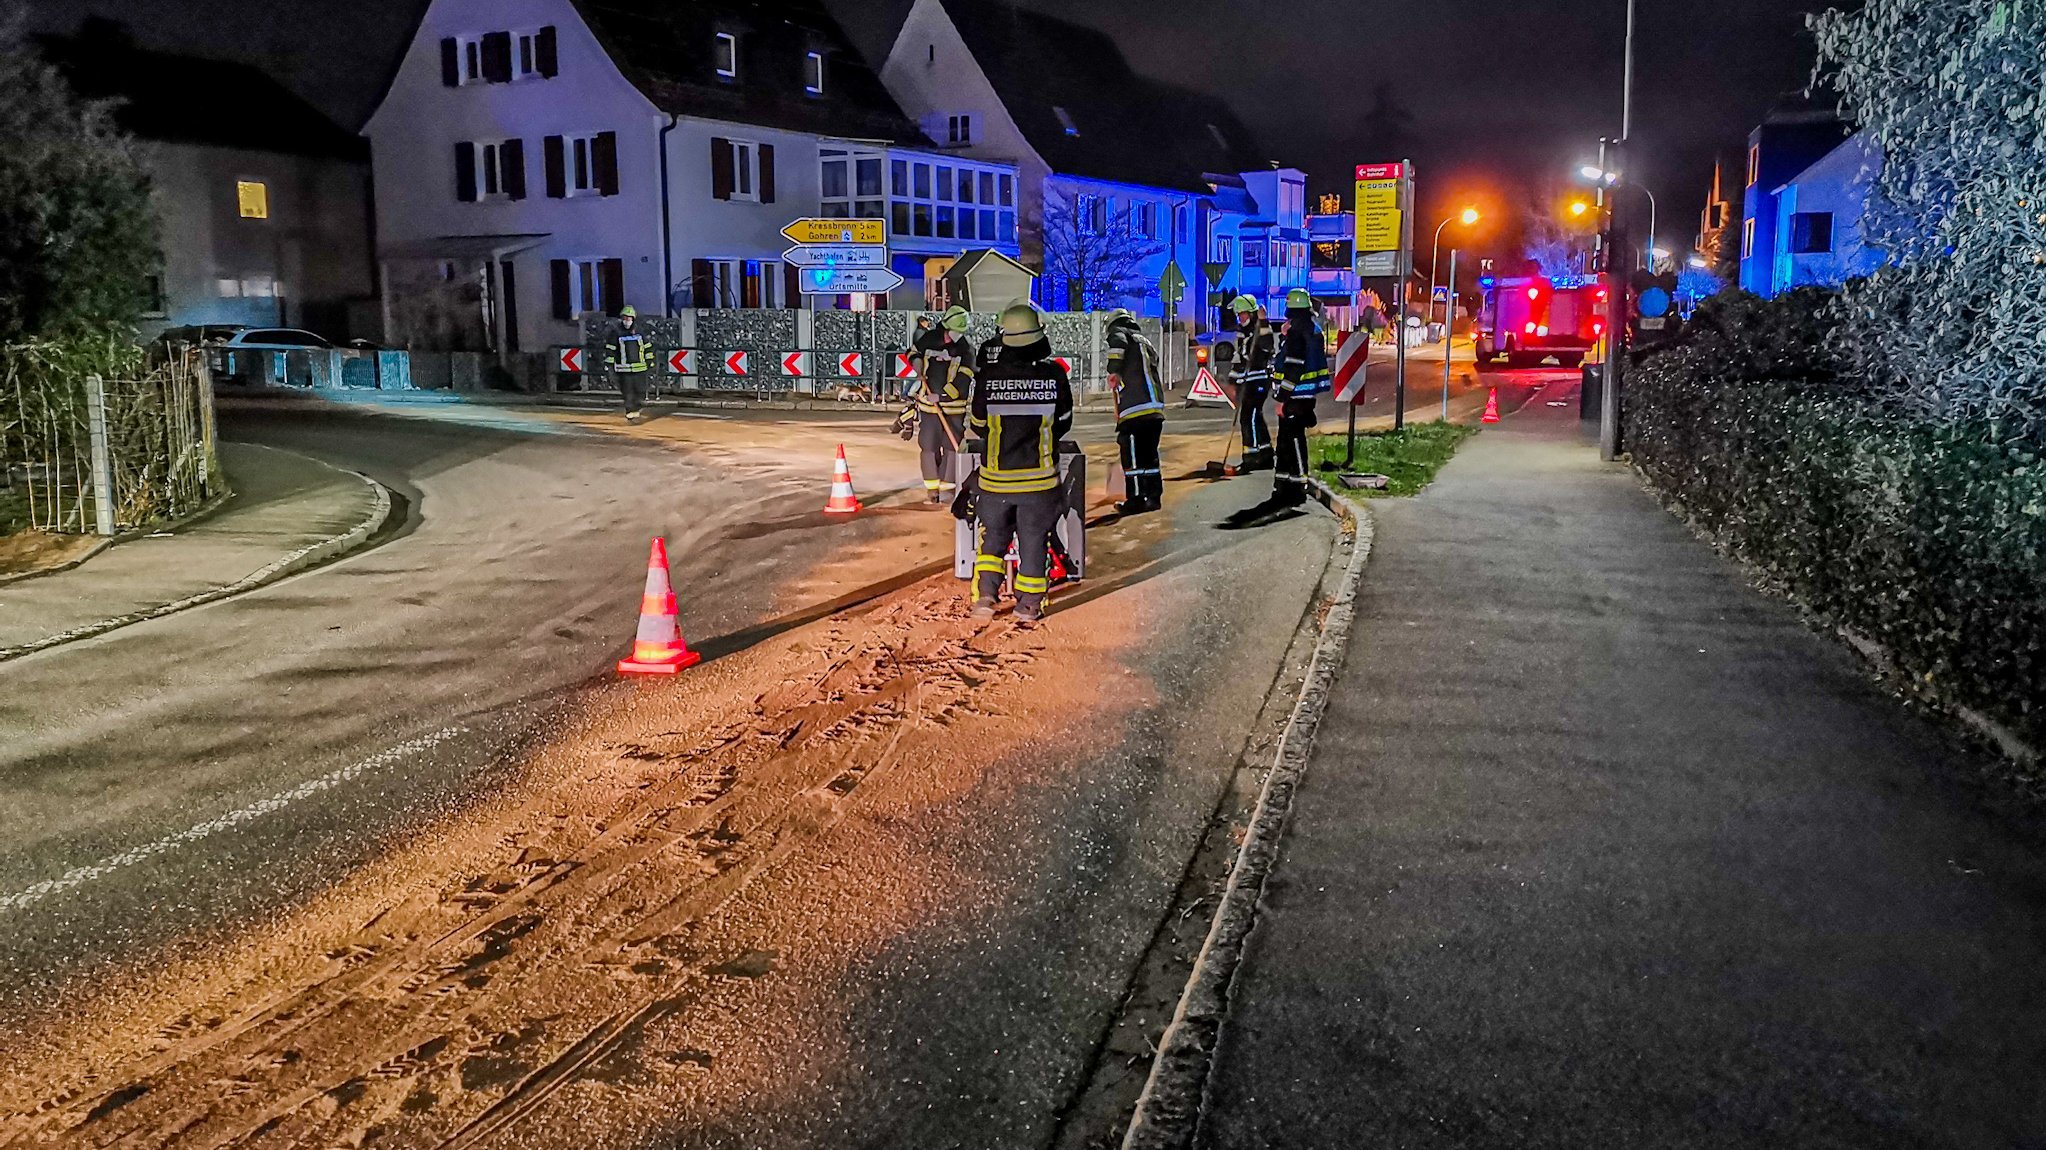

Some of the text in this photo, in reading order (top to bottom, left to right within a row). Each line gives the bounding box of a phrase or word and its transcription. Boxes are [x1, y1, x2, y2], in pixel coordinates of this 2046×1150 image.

[808, 222, 857, 230] Kressbronn
[860, 222, 865, 230] 5
[808, 232, 839, 240] Gohren
[860, 232, 865, 240] 2
[809, 252, 844, 261] Yachthafen
[985, 379, 1057, 390] FEUERWEHR
